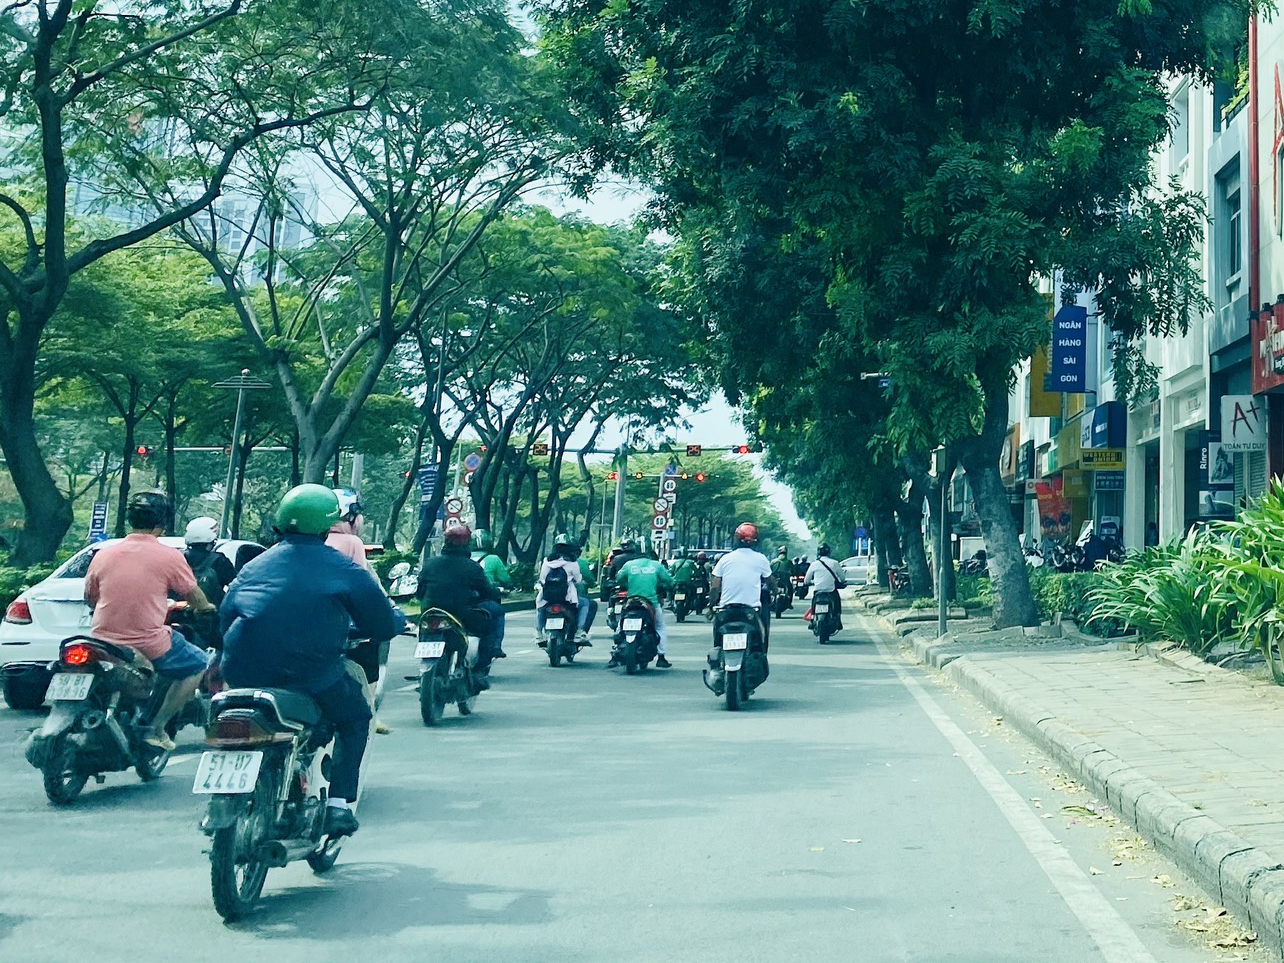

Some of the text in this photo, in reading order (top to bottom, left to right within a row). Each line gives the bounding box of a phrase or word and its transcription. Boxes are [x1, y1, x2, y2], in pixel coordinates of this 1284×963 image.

[1059, 320, 1081, 329] NGÂN
[1059, 337, 1081, 346] HÀNG
[1063, 356, 1076, 364] SÀI
[1060, 373, 1077, 382] GÒN
